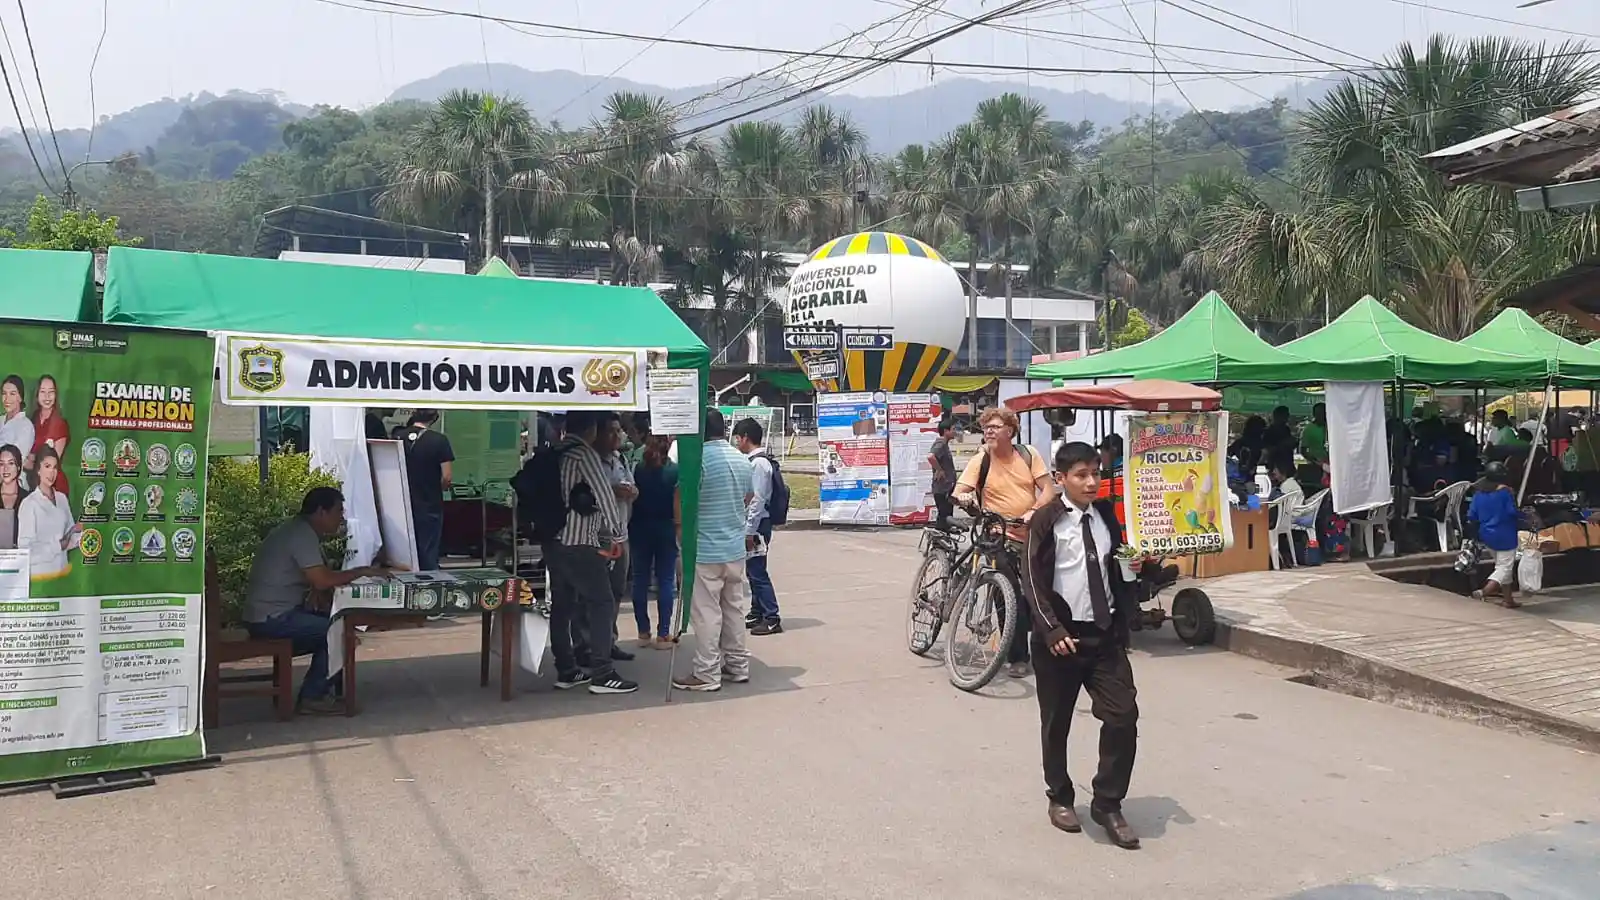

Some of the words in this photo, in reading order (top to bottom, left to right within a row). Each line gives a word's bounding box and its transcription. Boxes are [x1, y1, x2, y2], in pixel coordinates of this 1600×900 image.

[794, 264, 877, 285] UNIVERSIDAD
[792, 277, 854, 297] NACIONAL
[791, 289, 868, 314] AGRARIA
[791, 313, 800, 324] DE
[802, 310, 815, 321] LA
[72, 333, 94, 341] UNAS
[307, 357, 482, 392] ADMISIÓN
[489, 365, 575, 394] UNAS
[96, 382, 165, 401] EXAMEN
[170, 387, 192, 402] DE
[90, 399, 195, 421] ADMISION
[101, 420, 137, 428] CARRERAS
[138, 421, 193, 430] PROFESIONALES
[1152, 537, 1173, 548] 901
[1176, 536, 1197, 546] 603
[1200, 534, 1221, 545] 756
